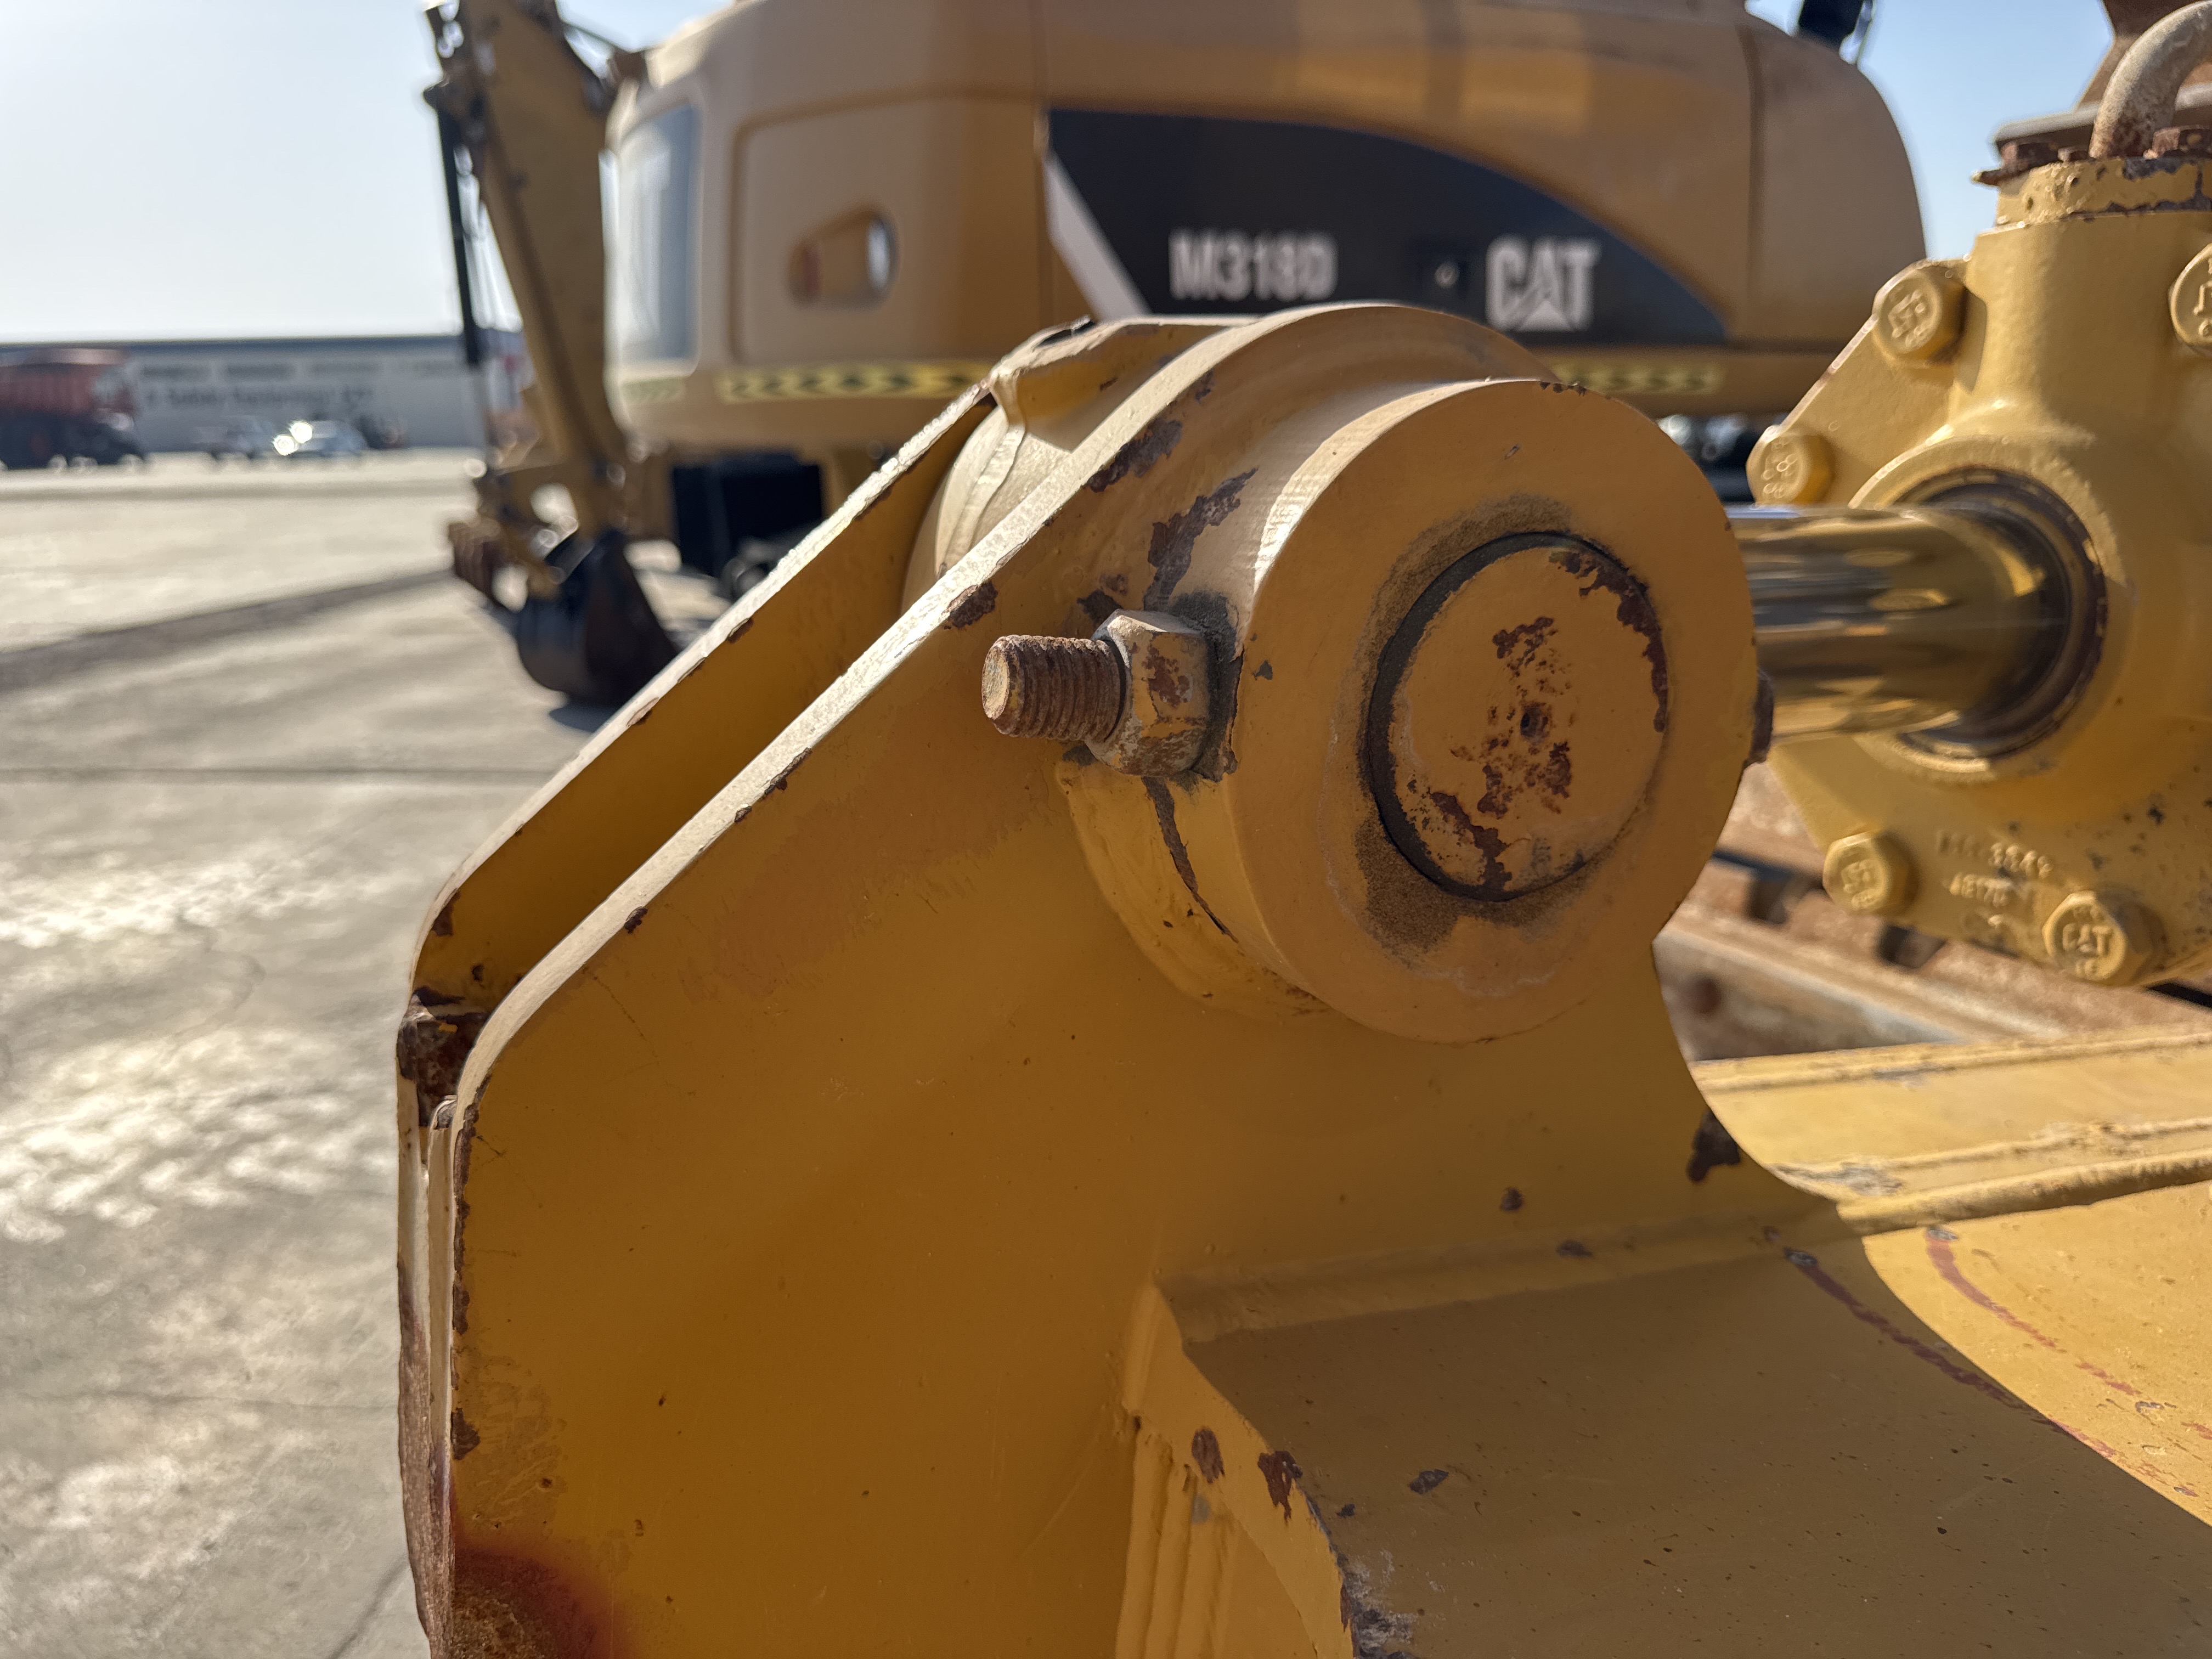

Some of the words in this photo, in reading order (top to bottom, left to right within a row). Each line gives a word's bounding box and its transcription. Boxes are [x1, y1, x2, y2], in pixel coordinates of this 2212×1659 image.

[1169, 230, 1338, 301] M318D
[1486, 236, 1600, 330] CAT
[2062, 923, 2111, 954] CAT
